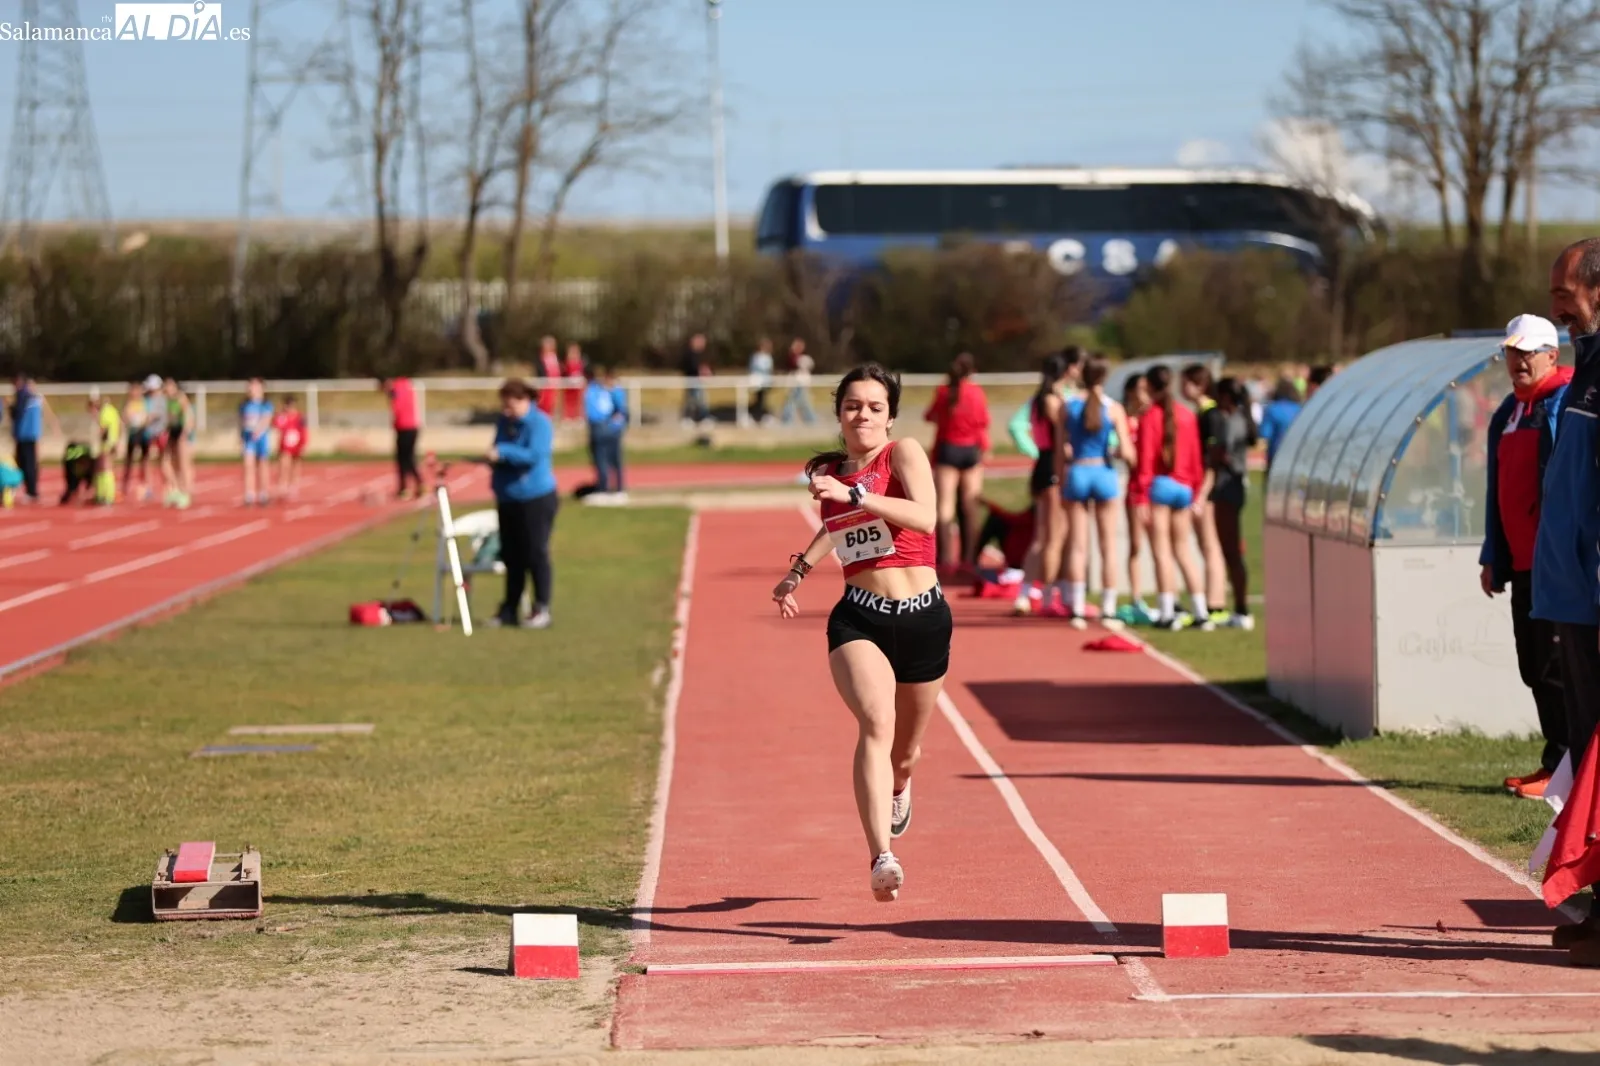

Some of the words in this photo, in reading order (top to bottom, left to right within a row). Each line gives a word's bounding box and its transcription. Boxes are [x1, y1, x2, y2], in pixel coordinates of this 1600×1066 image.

[845, 526, 882, 549] 605
[847, 586, 894, 614] NIKE
[897, 591, 933, 615] PRO
